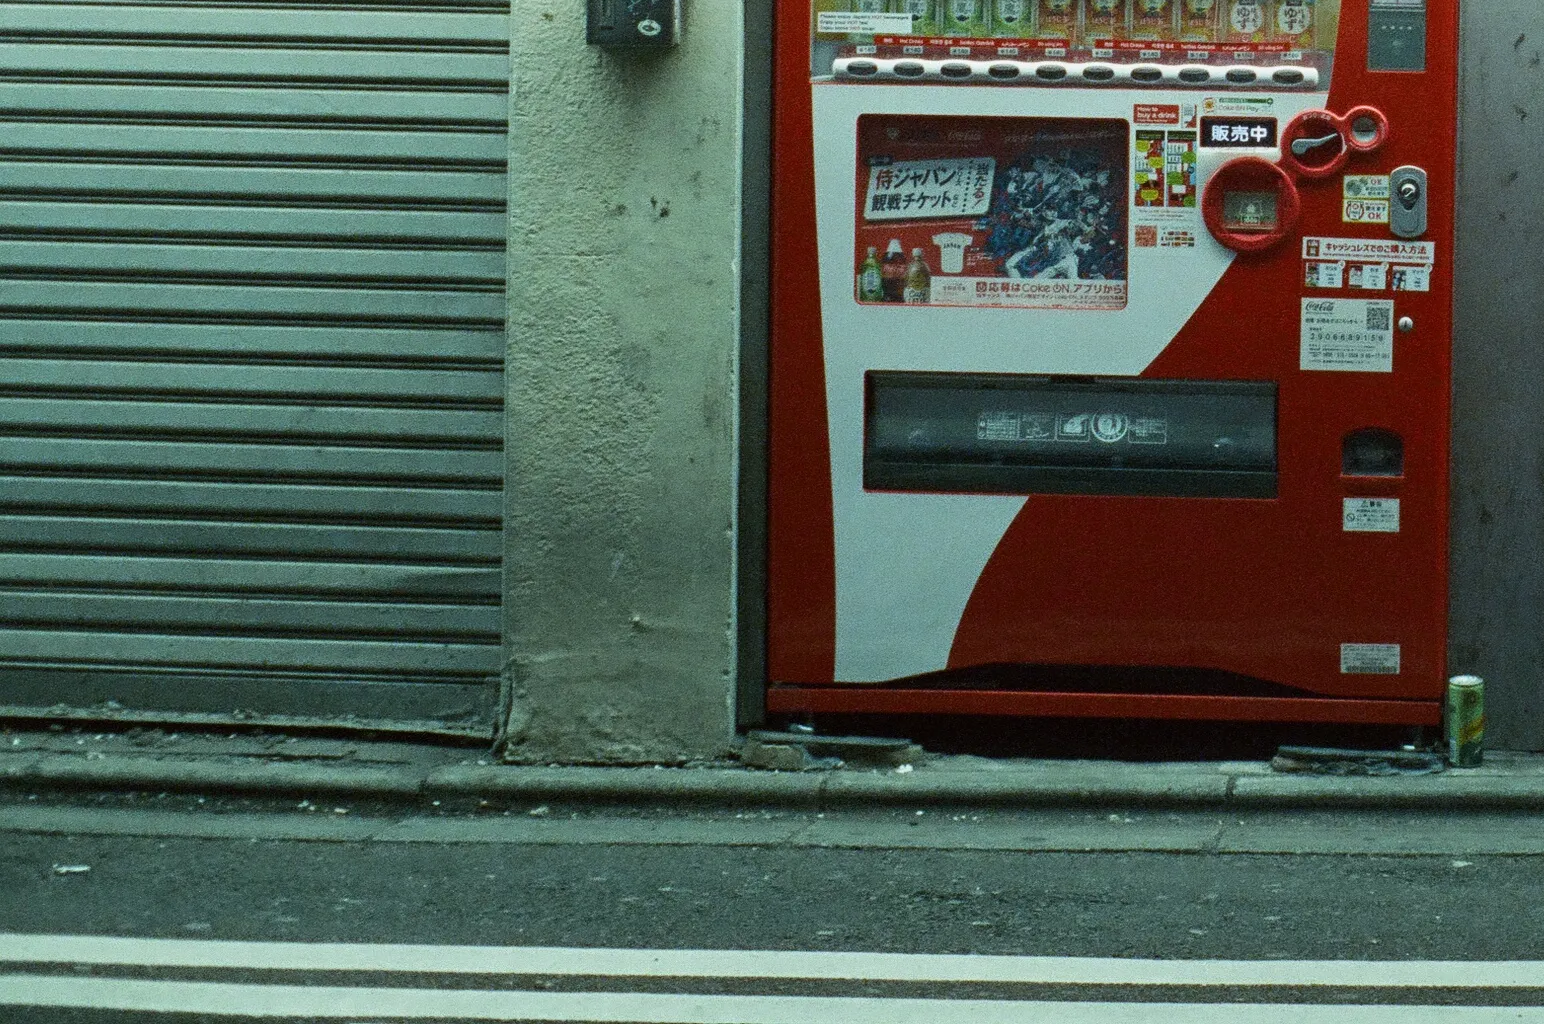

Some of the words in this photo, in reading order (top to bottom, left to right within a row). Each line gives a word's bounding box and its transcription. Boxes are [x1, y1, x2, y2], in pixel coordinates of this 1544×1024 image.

[1211, 125, 1268, 142] 販売中
[876, 166, 956, 190] 侍ジャパン
[872, 191, 951, 211] 観戦チケット
[1325, 243, 1427, 255] キャッシュレスでのご購入方法
[1022, 283, 1051, 293] Coke
[1305, 301, 1334, 312] Coca-Cola
